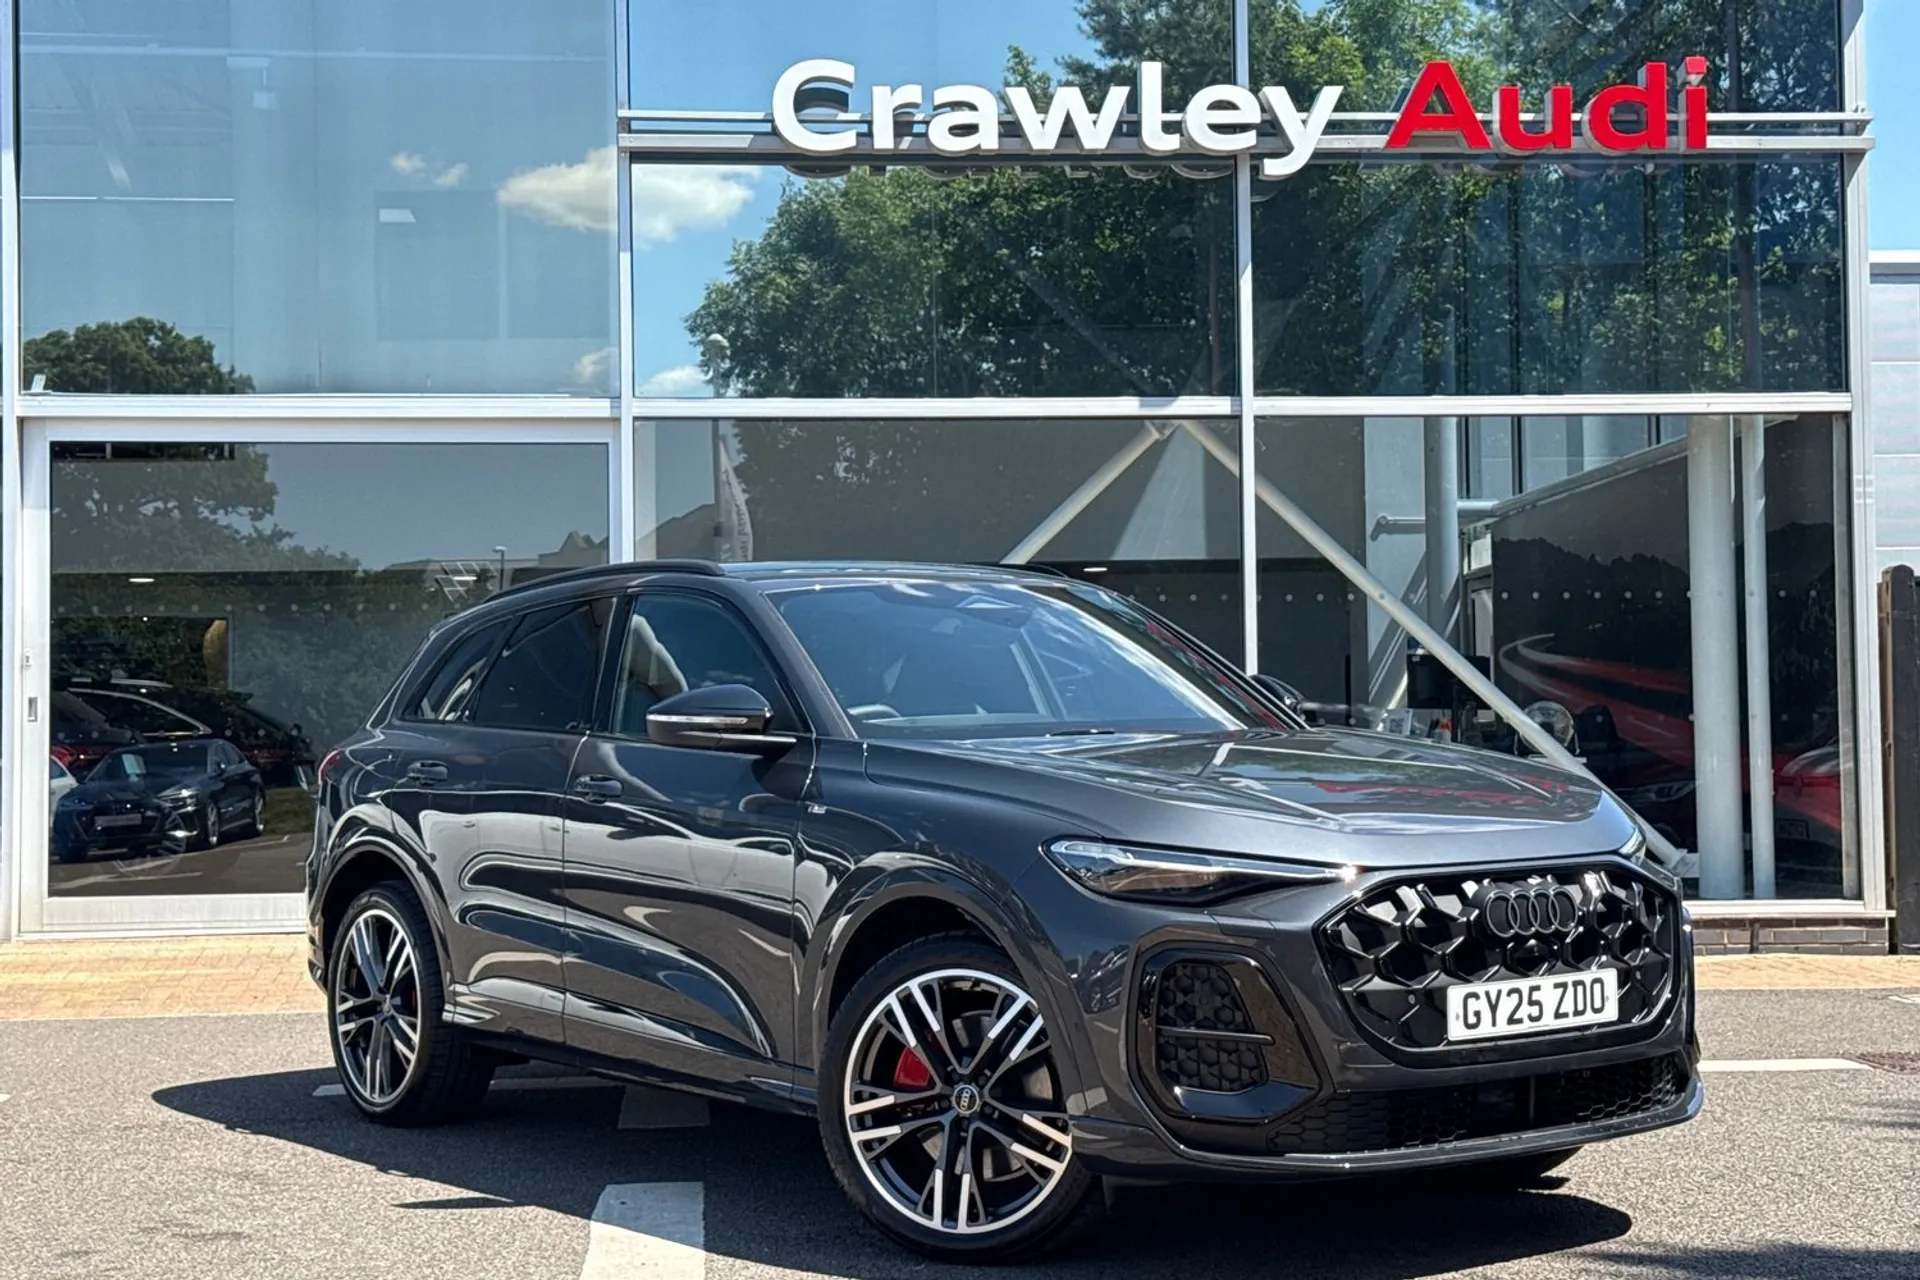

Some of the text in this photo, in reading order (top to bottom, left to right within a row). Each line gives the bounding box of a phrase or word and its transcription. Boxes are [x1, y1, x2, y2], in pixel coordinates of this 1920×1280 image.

[772, 56, 1708, 176] Crawley Audi
[1462, 977, 1606, 1030] GY25 ZDO
